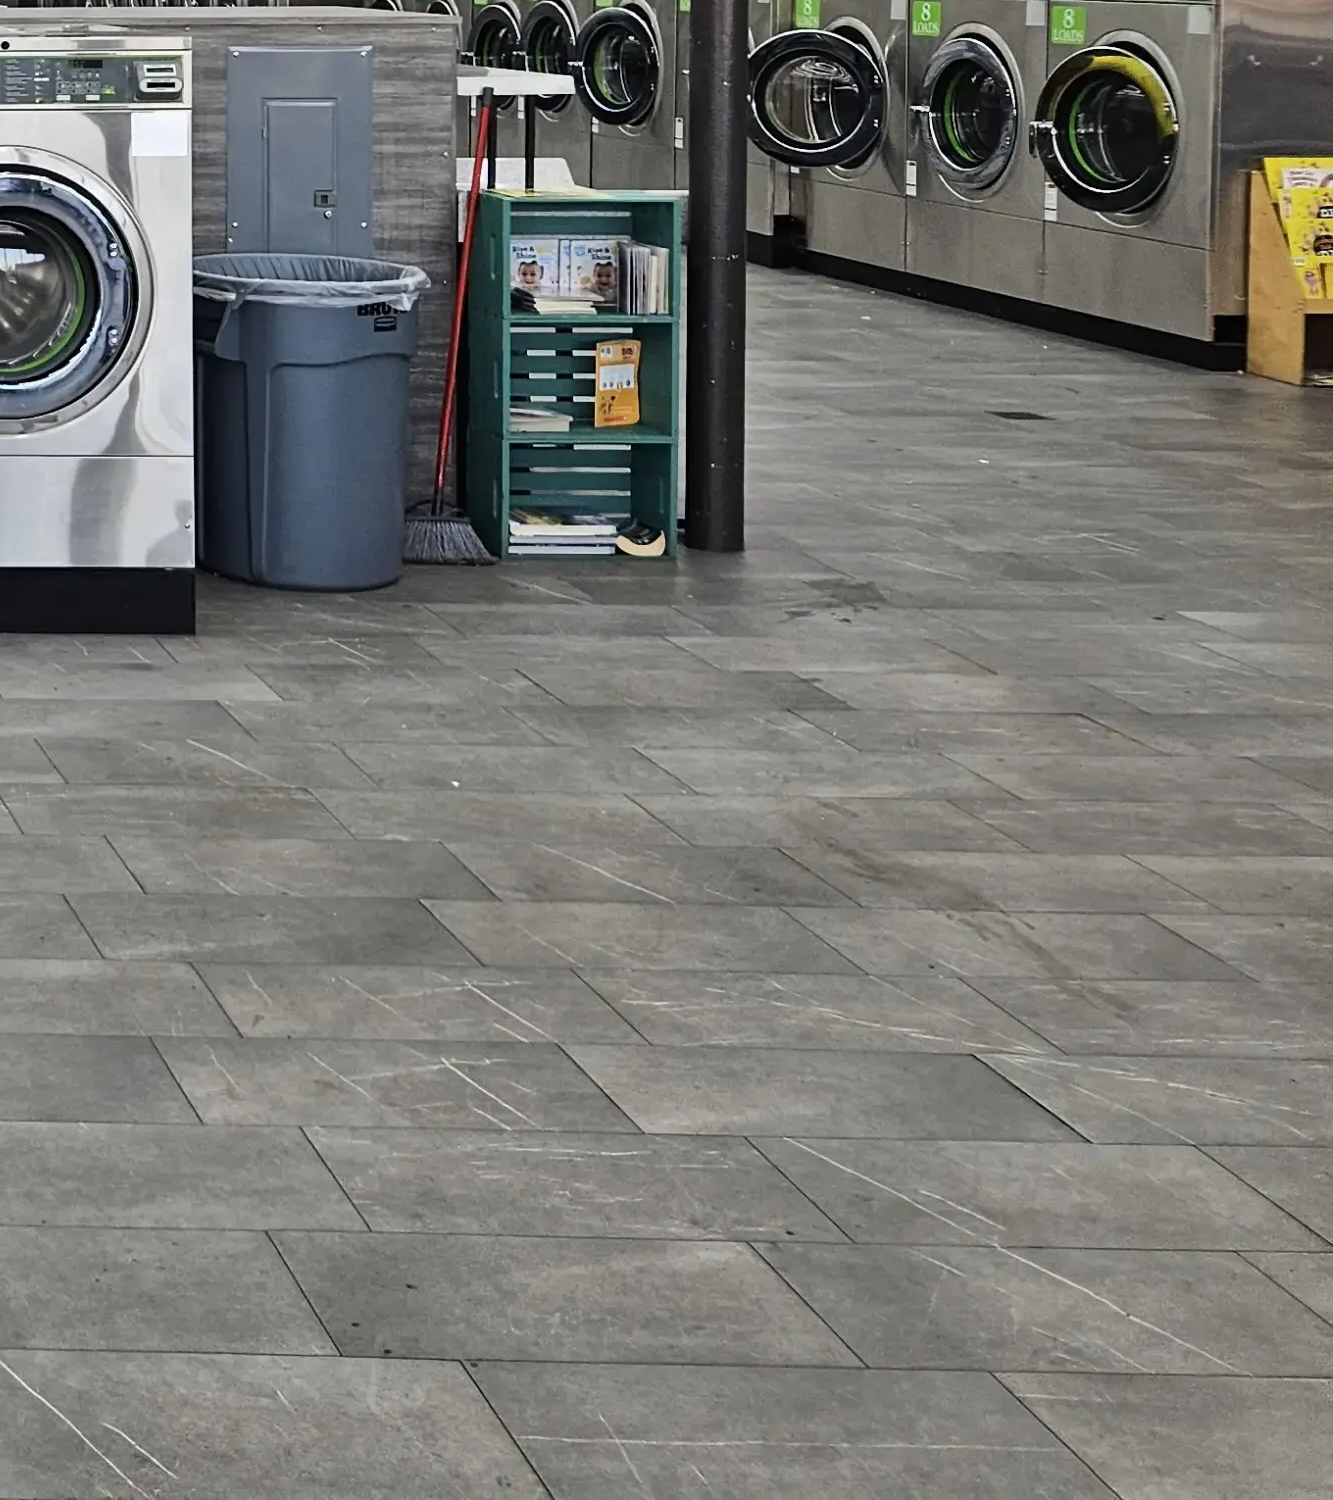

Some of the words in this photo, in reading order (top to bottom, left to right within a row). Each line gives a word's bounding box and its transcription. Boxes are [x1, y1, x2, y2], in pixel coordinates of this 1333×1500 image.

[803, 0, 812, 15] 8
[921, 2, 931, 21] 8
[1063, 9, 1074, 29] 8
[357, 301, 407, 316] BRU
